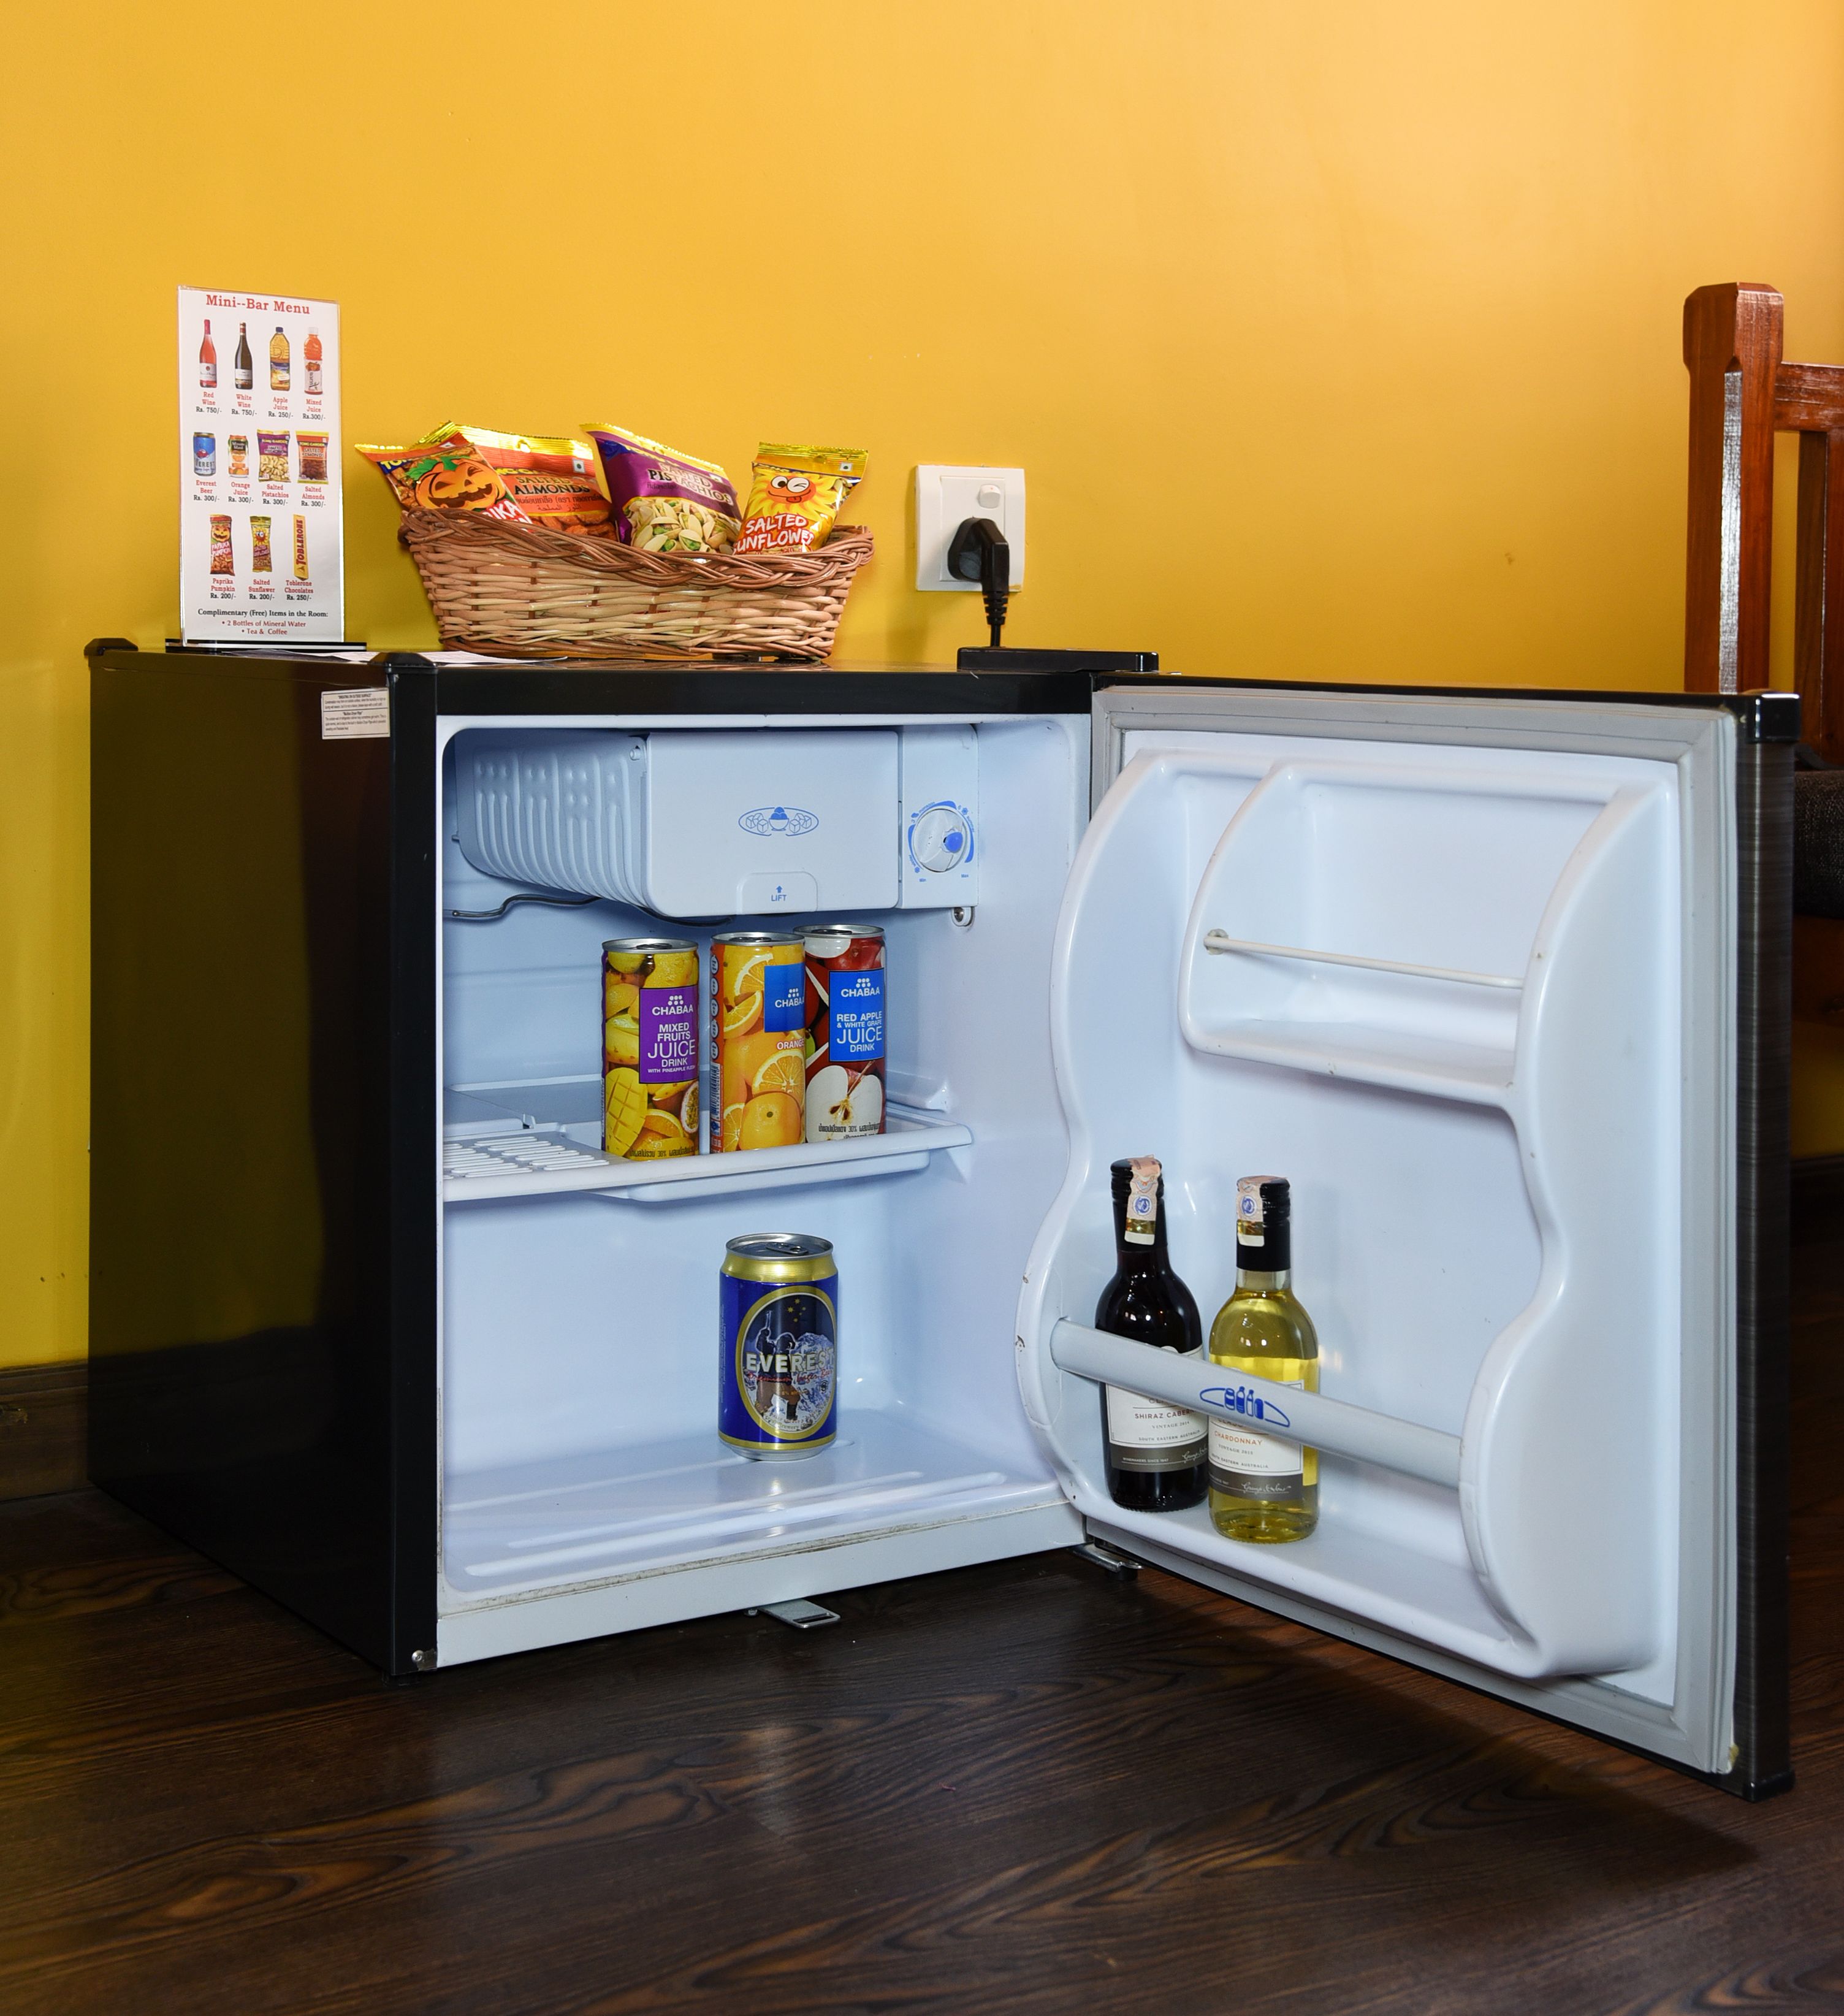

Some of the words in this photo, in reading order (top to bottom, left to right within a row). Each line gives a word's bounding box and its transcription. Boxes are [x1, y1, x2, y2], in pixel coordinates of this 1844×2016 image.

[273, 300, 310, 314] Menu
[658, 462, 713, 488] SALTED
[514, 483, 591, 495] ALMONDS
[647, 469, 734, 506] PISTACHIOS
[745, 513, 808, 535] SALTED
[296, 519, 306, 565] TOBLERONE
[197, 608, 248, 617] Complimentary
[840, 987, 880, 998] CHABAA
[652, 1004, 694, 1016] CHABAA
[836, 1014, 857, 1022] RED
[860, 1011, 882, 1021] APPLE
[659, 1022, 690, 1033] MIXED
[657, 1031, 691, 1042] FRUITS
[836, 1026, 882, 1044] JUICE
[647, 1039, 696, 1059] JUICE
[850, 1043, 875, 1053] DRINK
[661, 1058, 688, 1067] DRINK
[746, 1348, 834, 1373] EVEREST
[1180, 1429, 1200, 1438] AUSTRALIA
[1214, 1430, 1263, 1446] CHARDONNAY
[1218, 1443, 1240, 1453] VINTAGE
